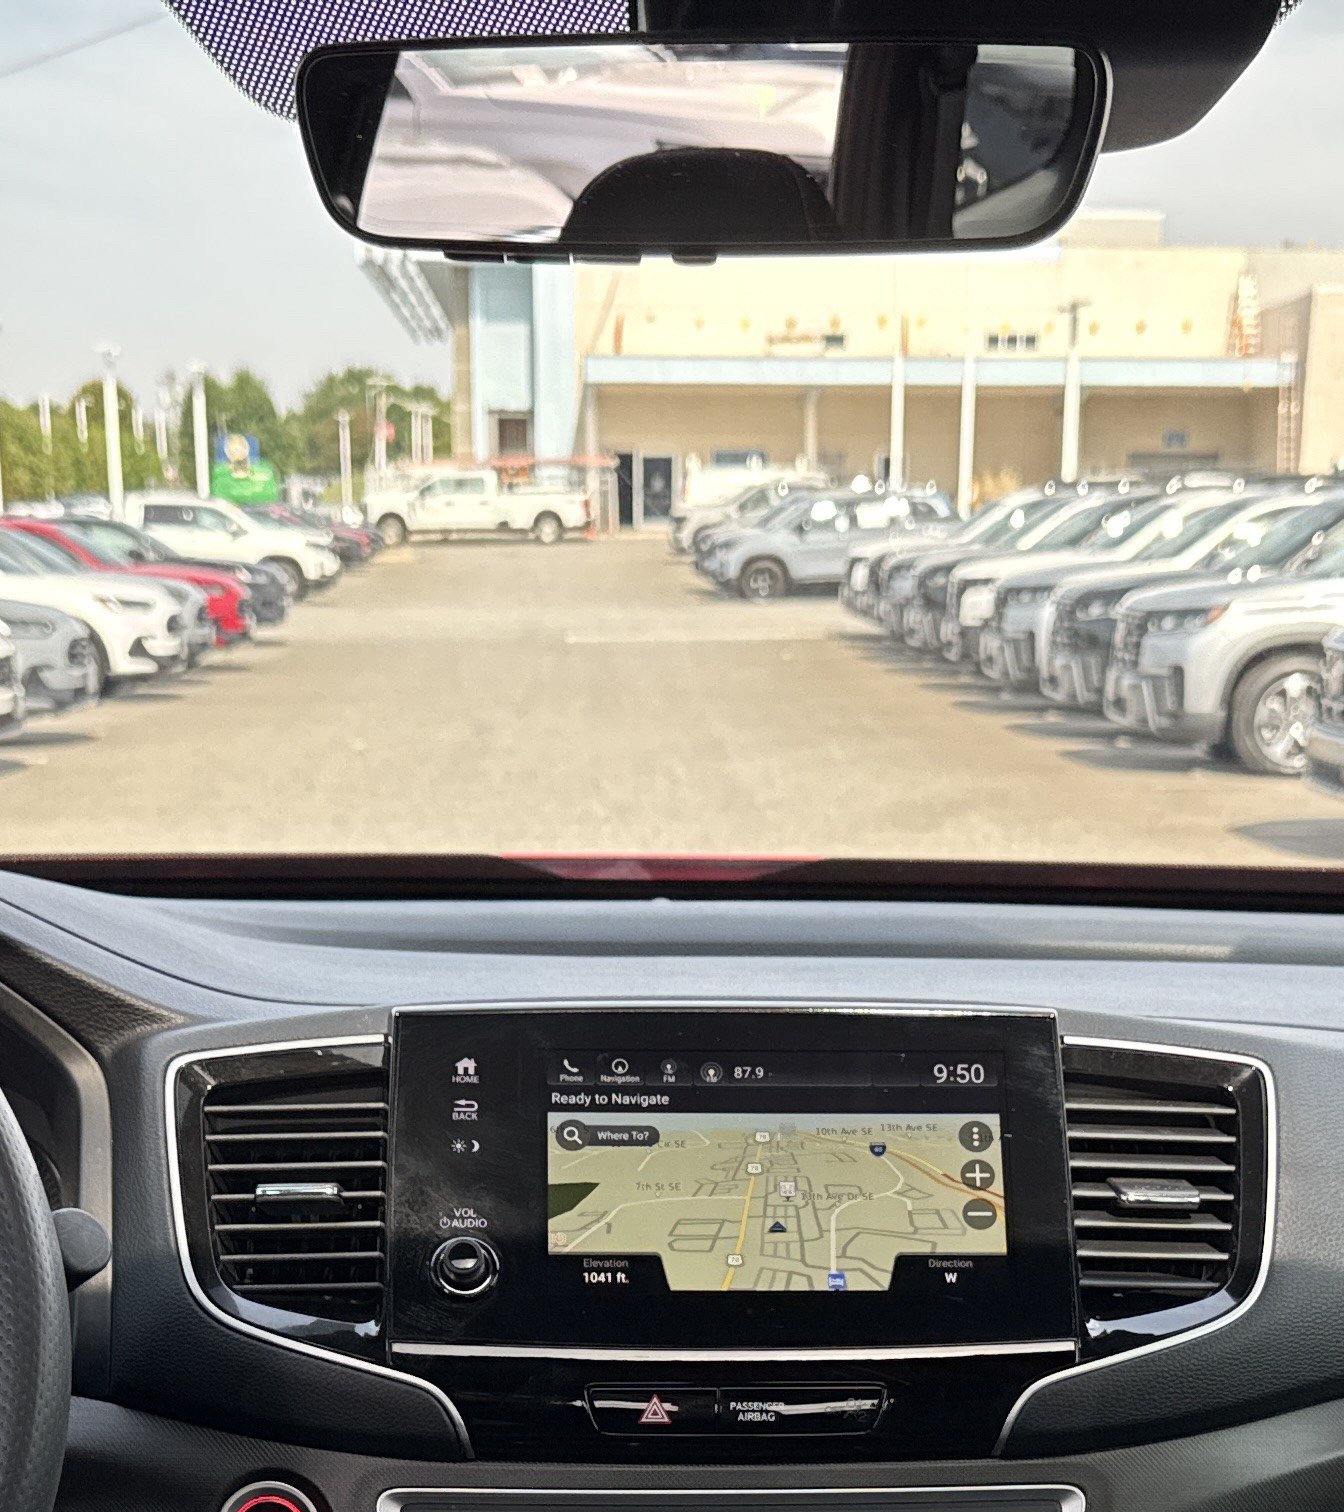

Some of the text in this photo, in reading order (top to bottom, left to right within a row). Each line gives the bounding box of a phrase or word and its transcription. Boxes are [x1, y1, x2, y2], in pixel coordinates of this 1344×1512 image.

[733, 1066, 765, 1080] 87.9
[933, 1063, 985, 1084] 9:50
[451, 1075, 480, 1084] HOME
[559, 1074, 584, 1083] Phone
[600, 1074, 641, 1085] Navigation
[662, 1075, 676, 1083] FM
[551, 1092, 670, 1108] Ready to Navigate
[451, 1112, 479, 1121] BACK
[840, 1127, 859, 1136] Ave
[861, 1127, 874, 1136] SE
[905, 1123, 925, 1132] Ave
[927, 1123, 939, 1132] SE
[596, 1130, 650, 1141] Where To?
[674, 1140, 687, 1149] SE
[668, 1182, 682, 1192] SE
[861, 1192, 875, 1201] SE
[453, 1207, 477, 1218] VOL
[451, 1218, 488, 1229] AUDIO
[583, 1258, 629, 1268] Elevation
[928, 1258, 973, 1268] Direction
[583, 1272, 613, 1284] 1041
[944, 1272, 958, 1283] W
[729, 1402, 785, 1412] PASSENGER
[737, 1412, 776, 1422] AIRBAG
